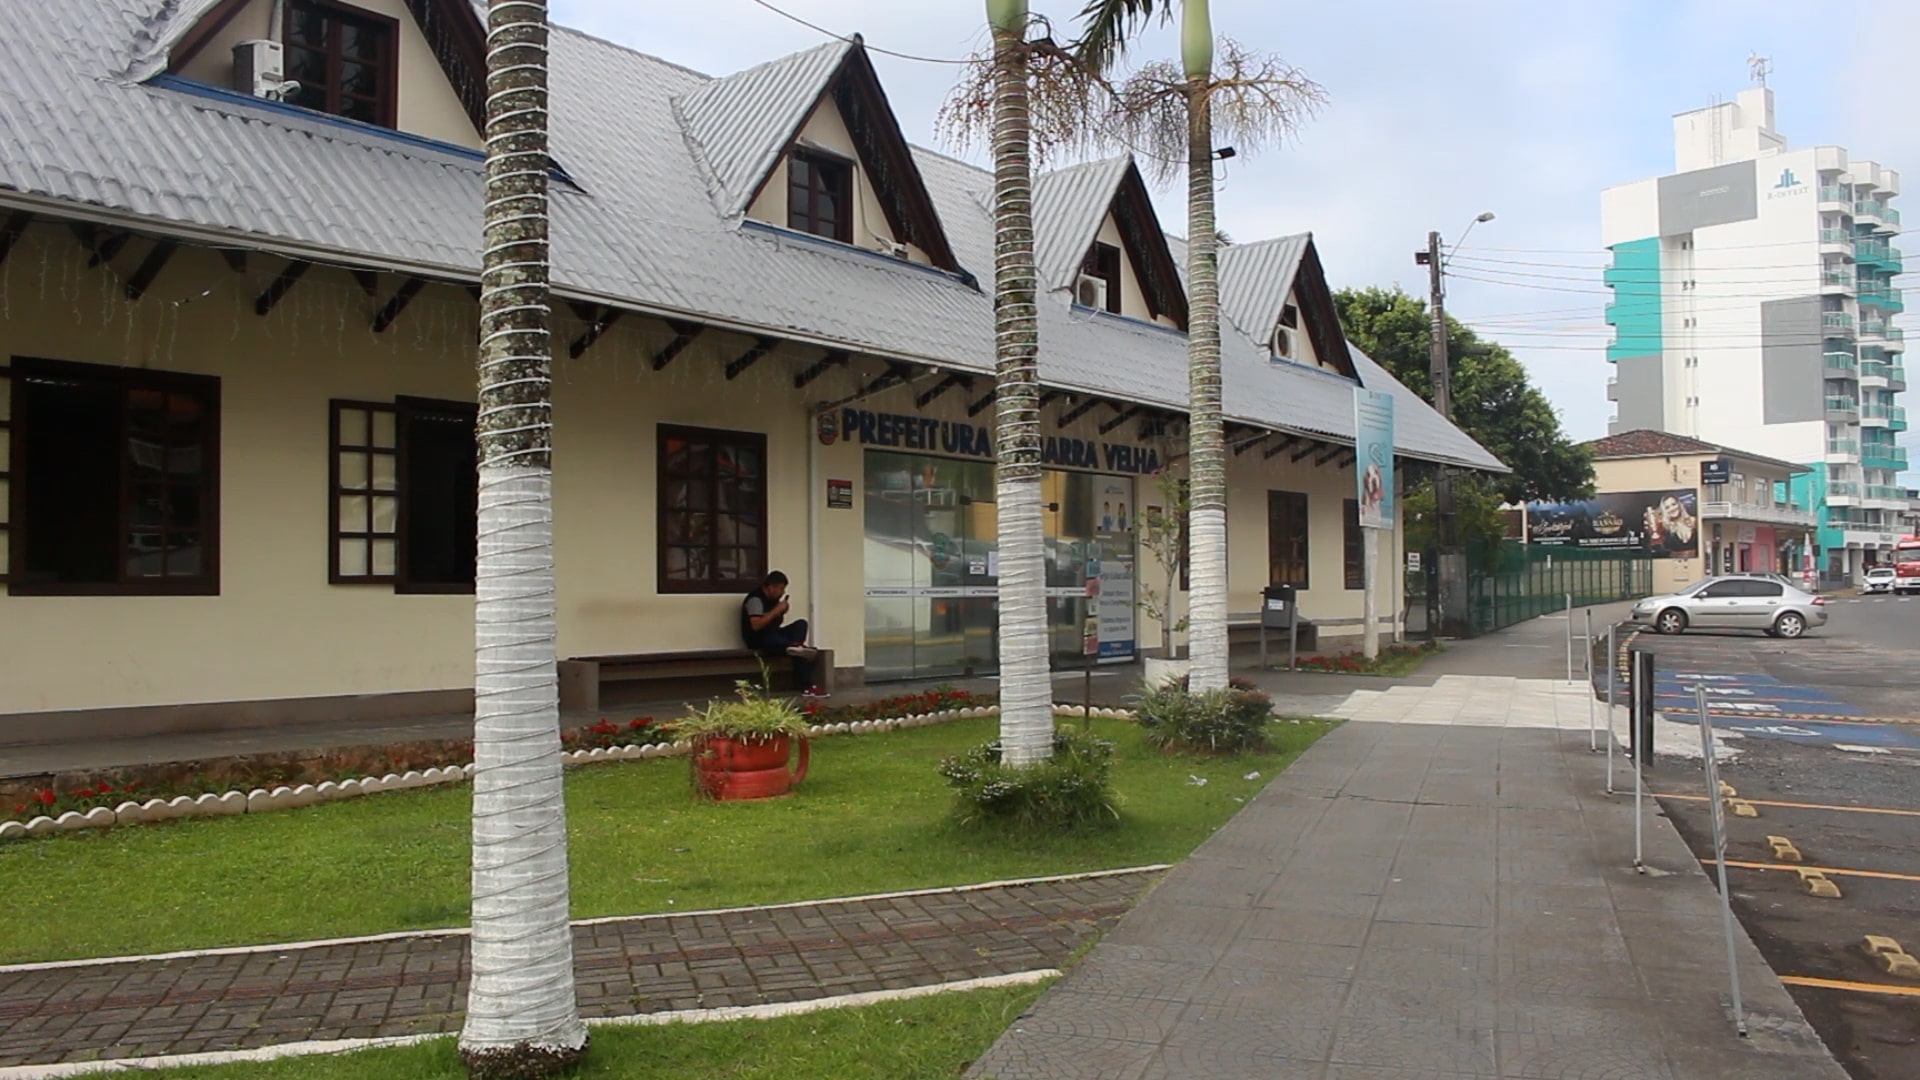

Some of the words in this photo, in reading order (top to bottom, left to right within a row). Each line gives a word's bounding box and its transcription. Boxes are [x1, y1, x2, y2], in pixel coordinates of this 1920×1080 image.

[842, 408, 992, 457] PREFEITURA
[1040, 436, 1100, 469] ARRA
[1103, 443, 1160, 475] VELHA
